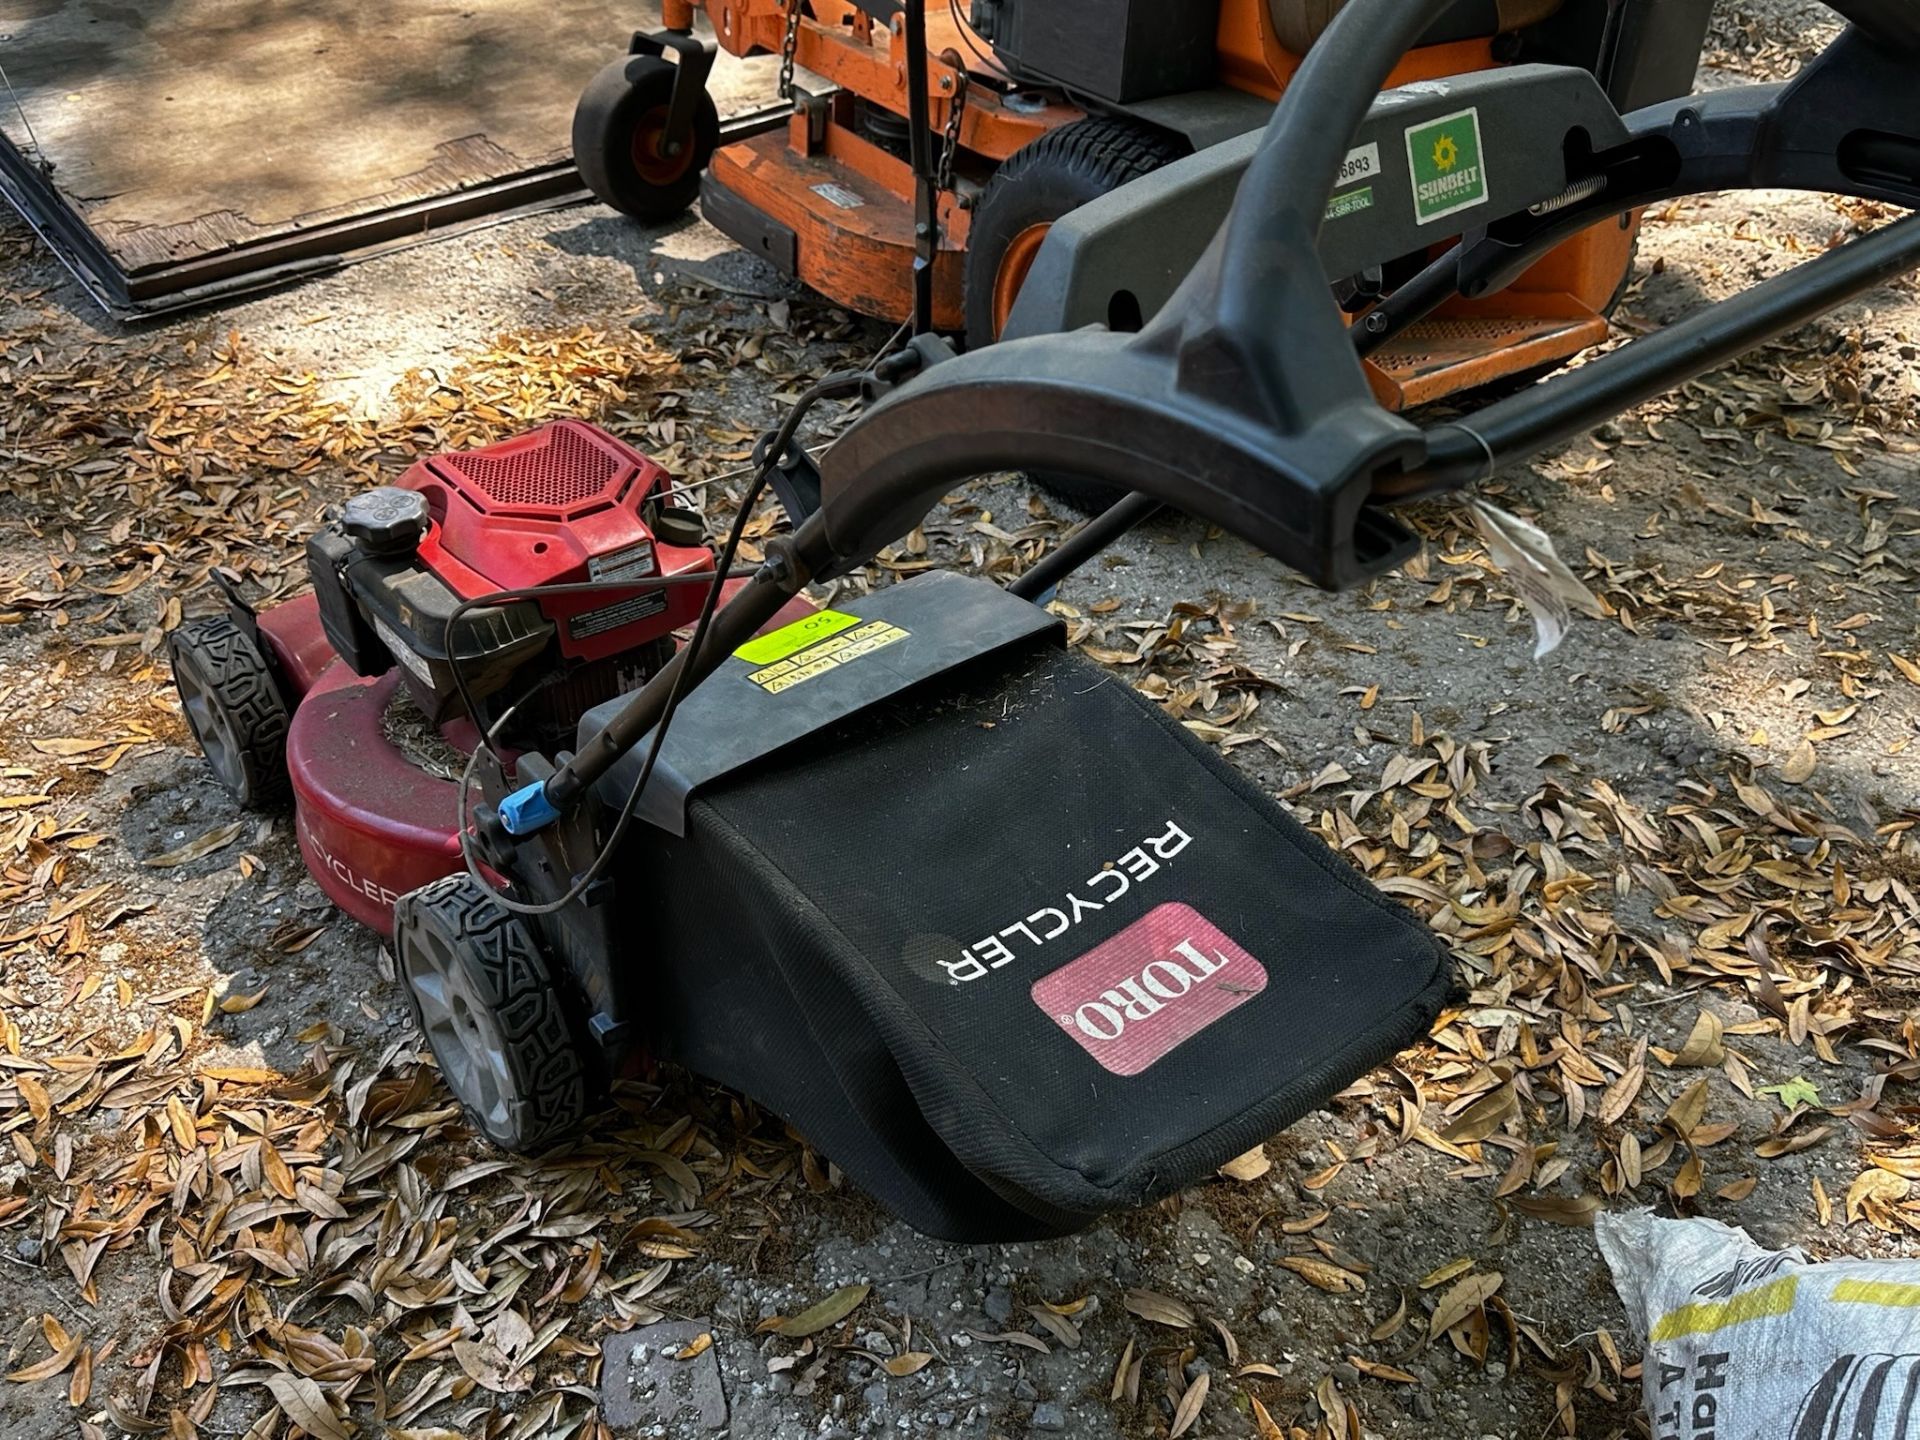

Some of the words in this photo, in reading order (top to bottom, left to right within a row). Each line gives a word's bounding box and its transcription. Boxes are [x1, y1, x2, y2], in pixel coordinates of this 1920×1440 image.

[1338, 156, 1370, 179] 6893
[1418, 166, 1478, 201] SUNBELT
[1428, 185, 1472, 205] RENTALS
[937, 820, 1193, 983] RECYCLER
[1074, 938, 1230, 1040] TORO
[1692, 1352, 1730, 1440] Ha
